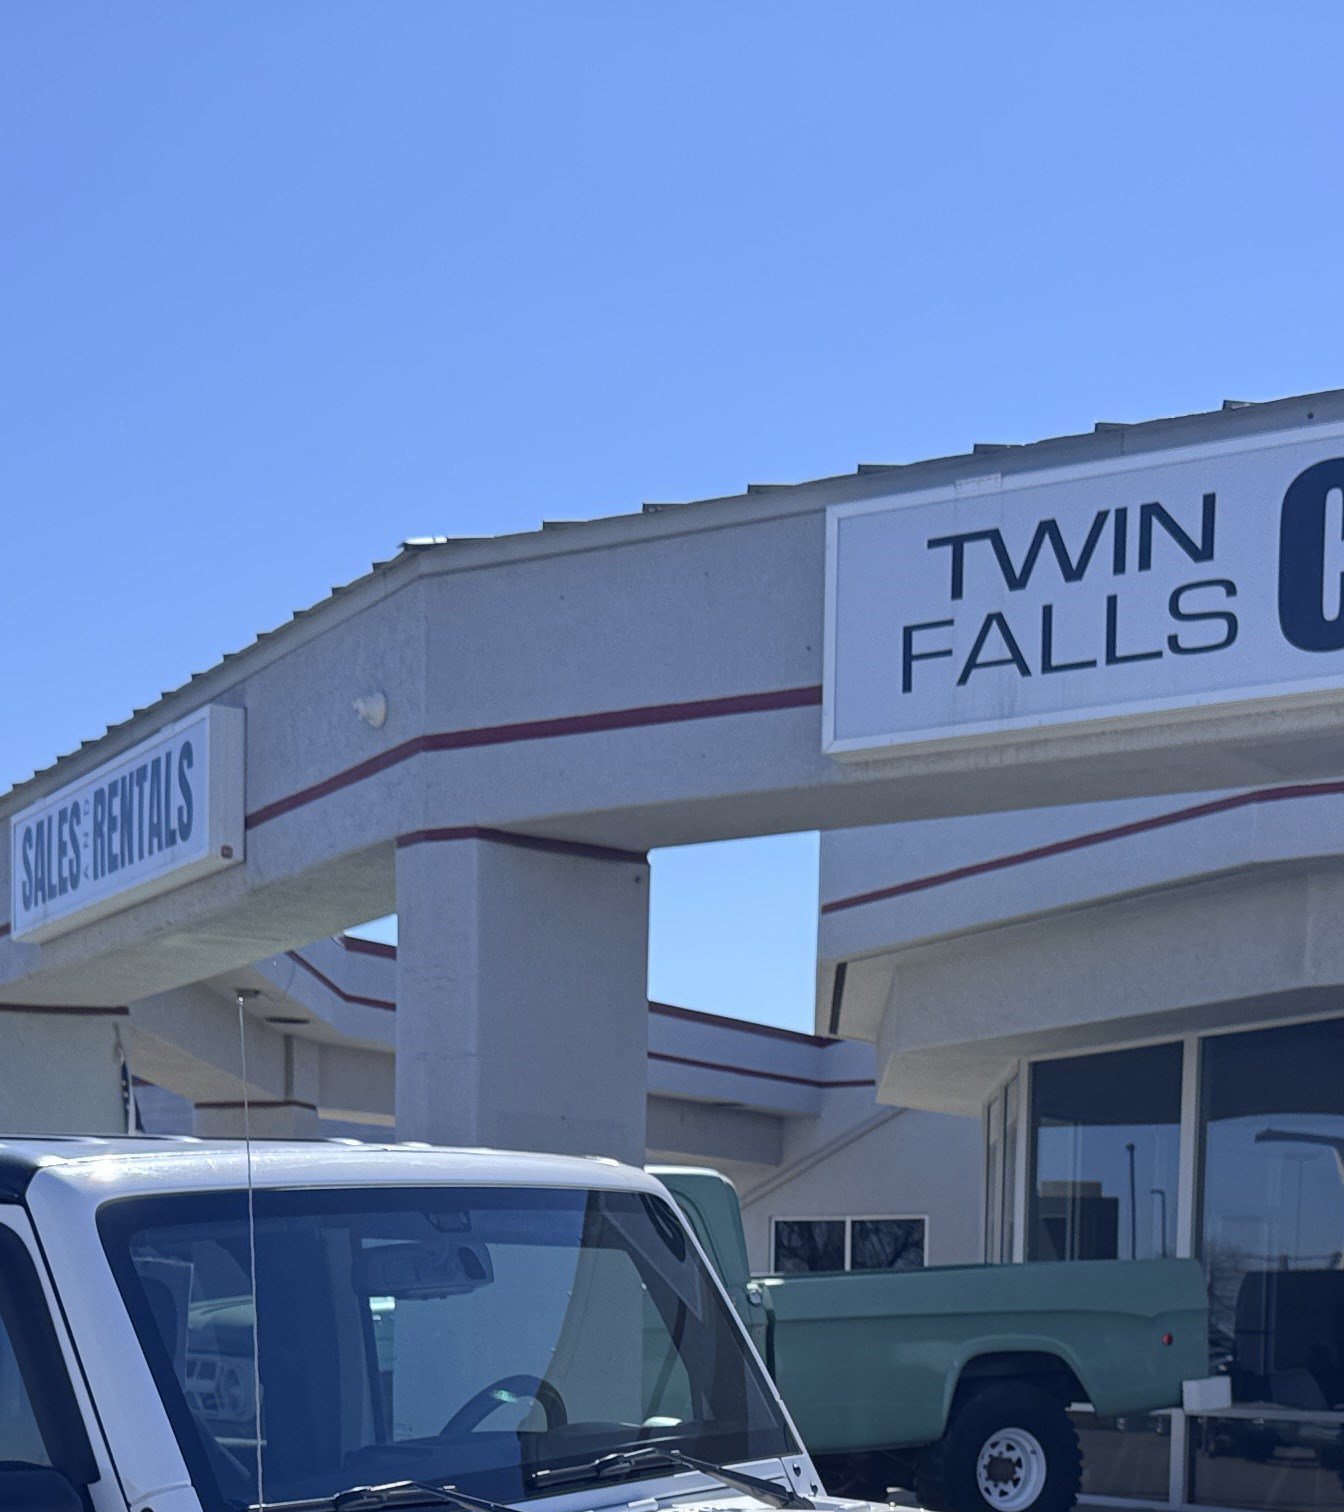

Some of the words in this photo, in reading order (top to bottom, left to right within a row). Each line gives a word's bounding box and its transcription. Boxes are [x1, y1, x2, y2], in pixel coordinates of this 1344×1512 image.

[927, 492, 1216, 600] TWIN
[902, 579, 1238, 693] FALLS
[21, 800, 82, 912] SALES
[93, 740, 194, 881] RENTALS
